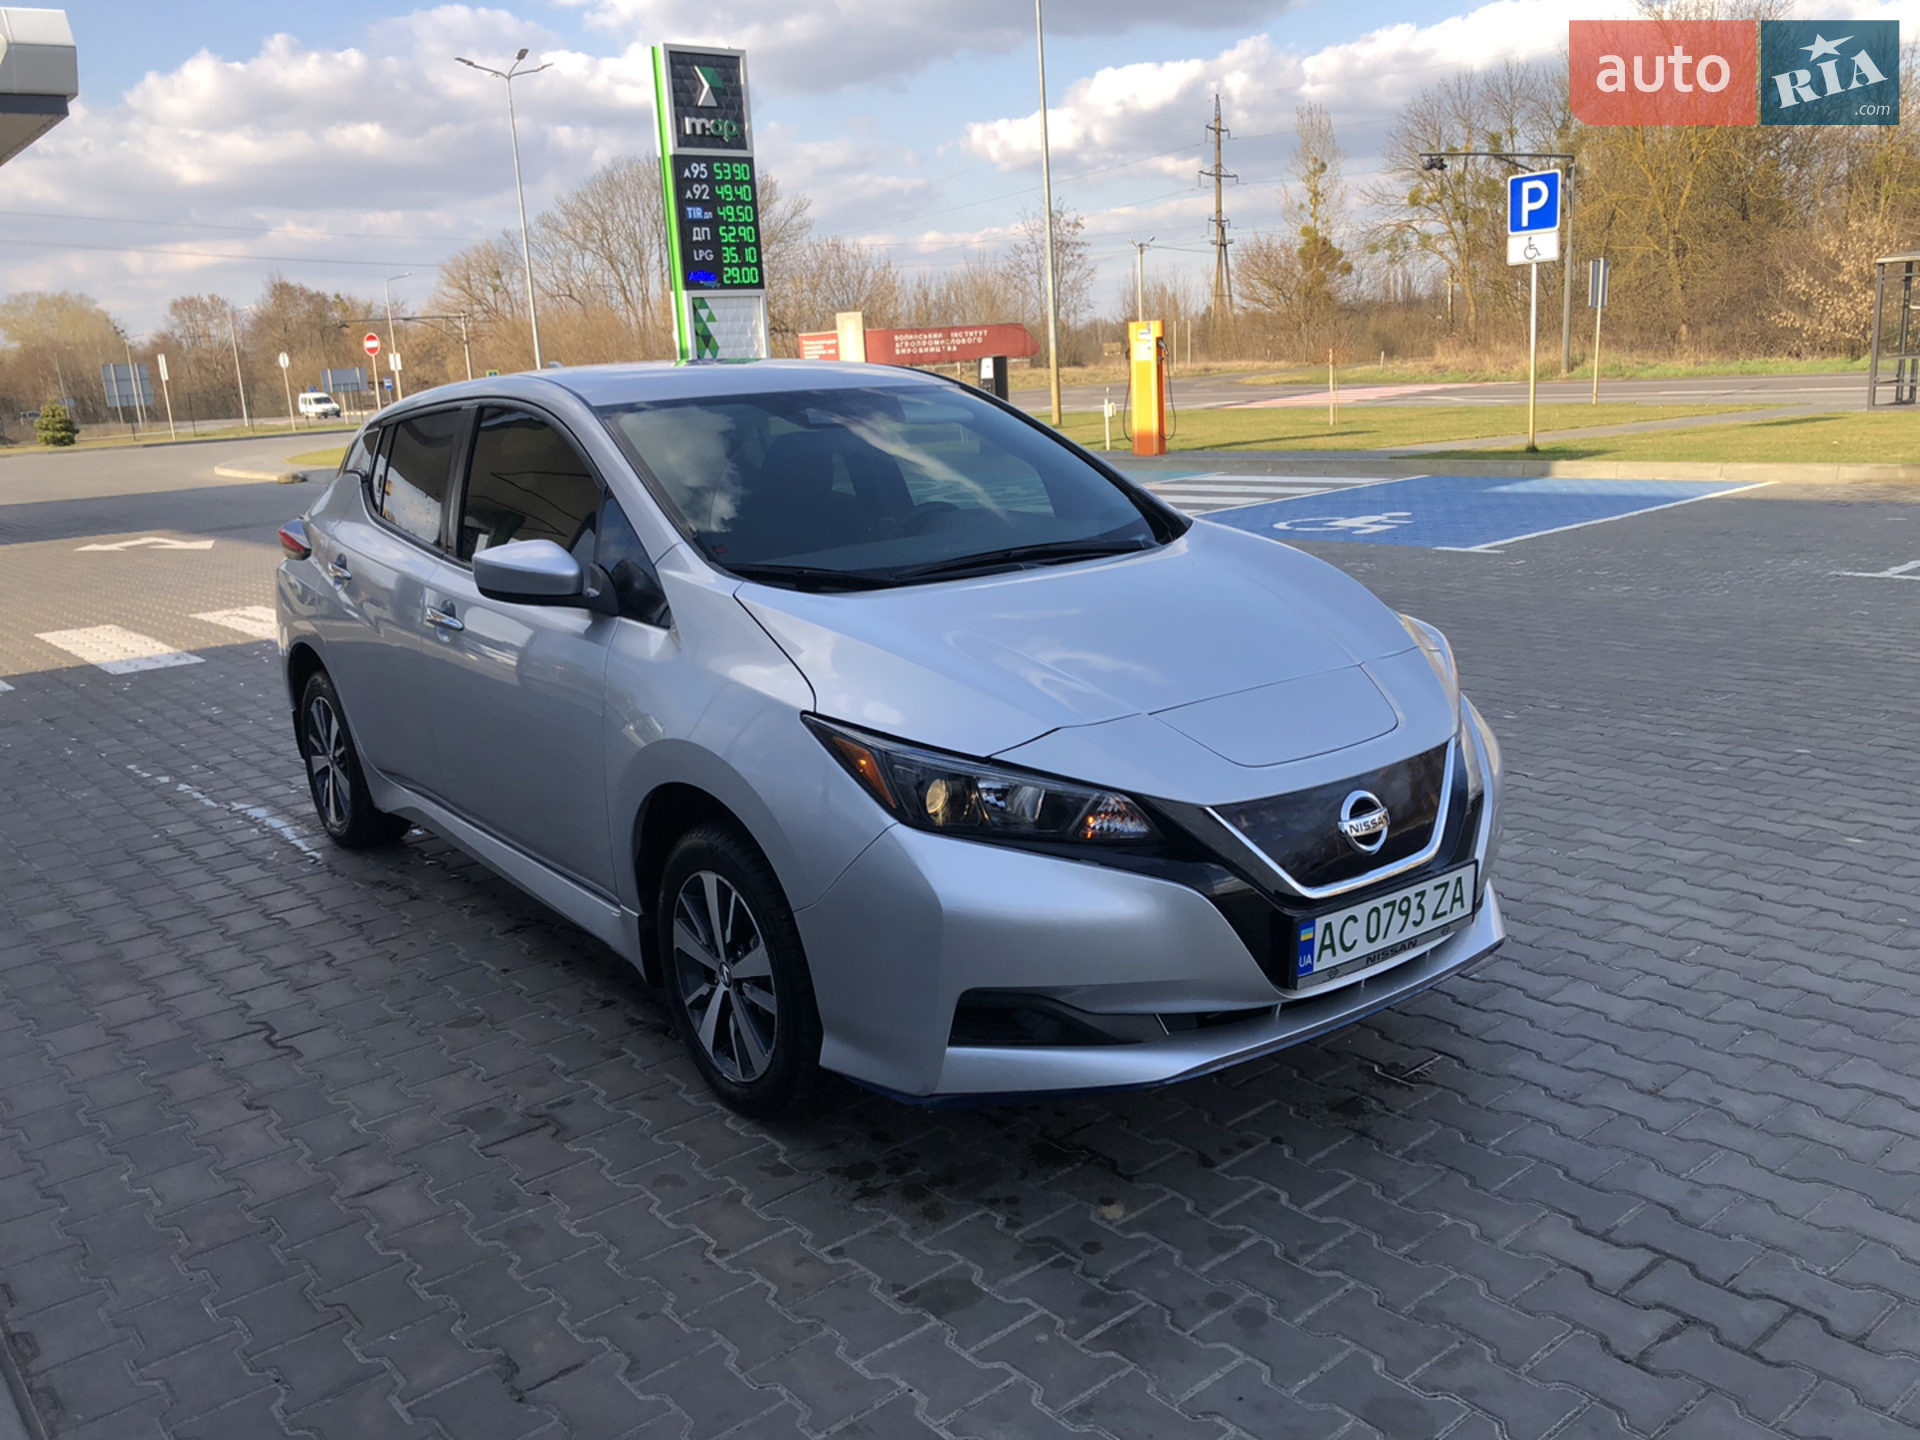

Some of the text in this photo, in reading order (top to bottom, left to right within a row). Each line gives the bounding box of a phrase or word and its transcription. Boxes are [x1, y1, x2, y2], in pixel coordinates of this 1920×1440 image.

[715, 184, 753, 202] 49.40
[1521, 180, 1549, 228] P
[686, 207, 704, 220] TIR
[716, 205, 755, 222] 49.50
[692, 226, 756, 243] ДП 52.90
[693, 246, 757, 264] LPG 35.10
[1349, 811, 1388, 834] NISSAN
[1316, 876, 1465, 963] AC 0793 ZA
[1299, 953, 1313, 968] UA
[1366, 939, 1419, 965] NISSAN
